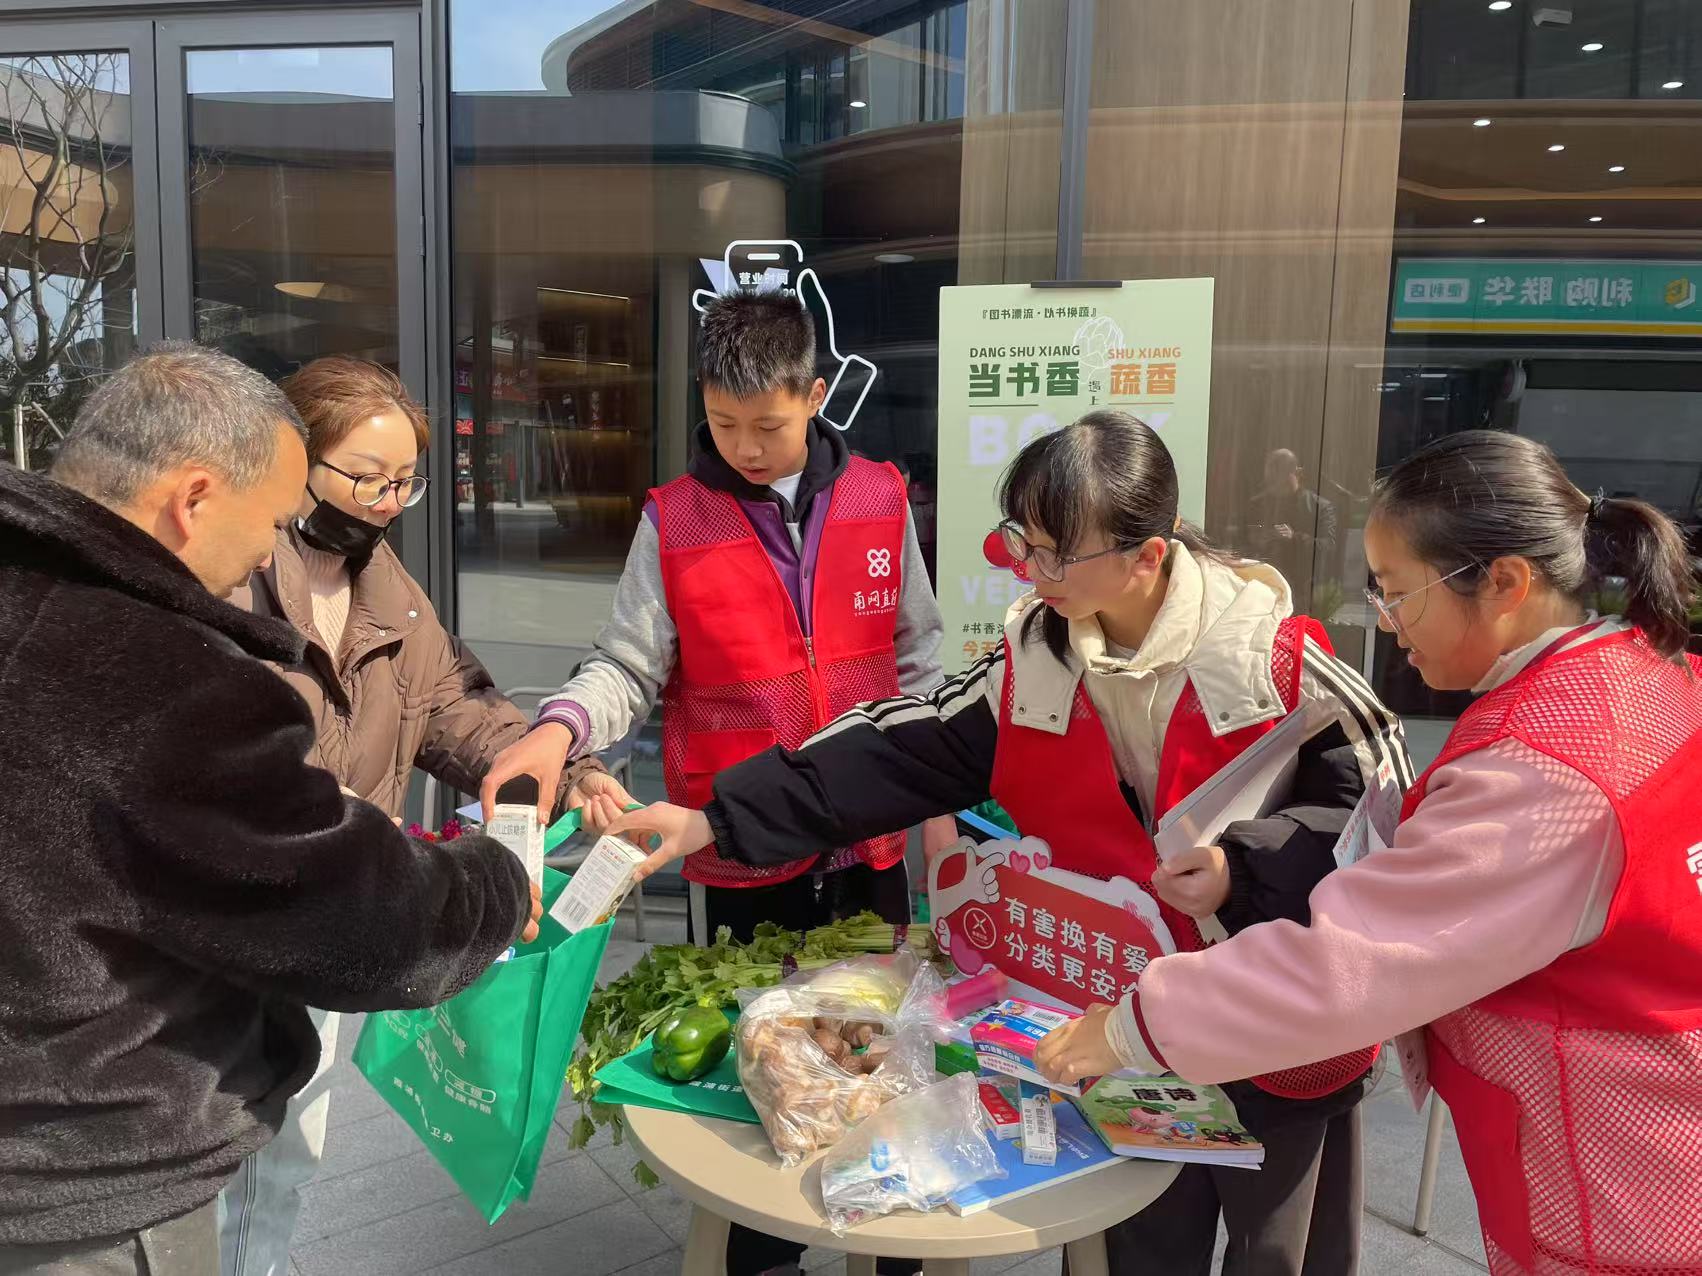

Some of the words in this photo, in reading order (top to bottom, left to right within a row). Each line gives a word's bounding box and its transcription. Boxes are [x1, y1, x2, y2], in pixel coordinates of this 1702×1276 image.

[970, 347, 1006, 358] DANG
[1009, 346, 1036, 358] SHU
[1039, 345, 1080, 357] XIANG
[1108, 348, 1135, 359] SHU
[1139, 347, 1181, 359] XIANG
[969, 361, 1080, 398] 当书香
[1110, 362, 1177, 395] 蔬香
[1004, 897, 1150, 974] 有害换有爱
[1004, 932, 1138, 1002] 分类更安
